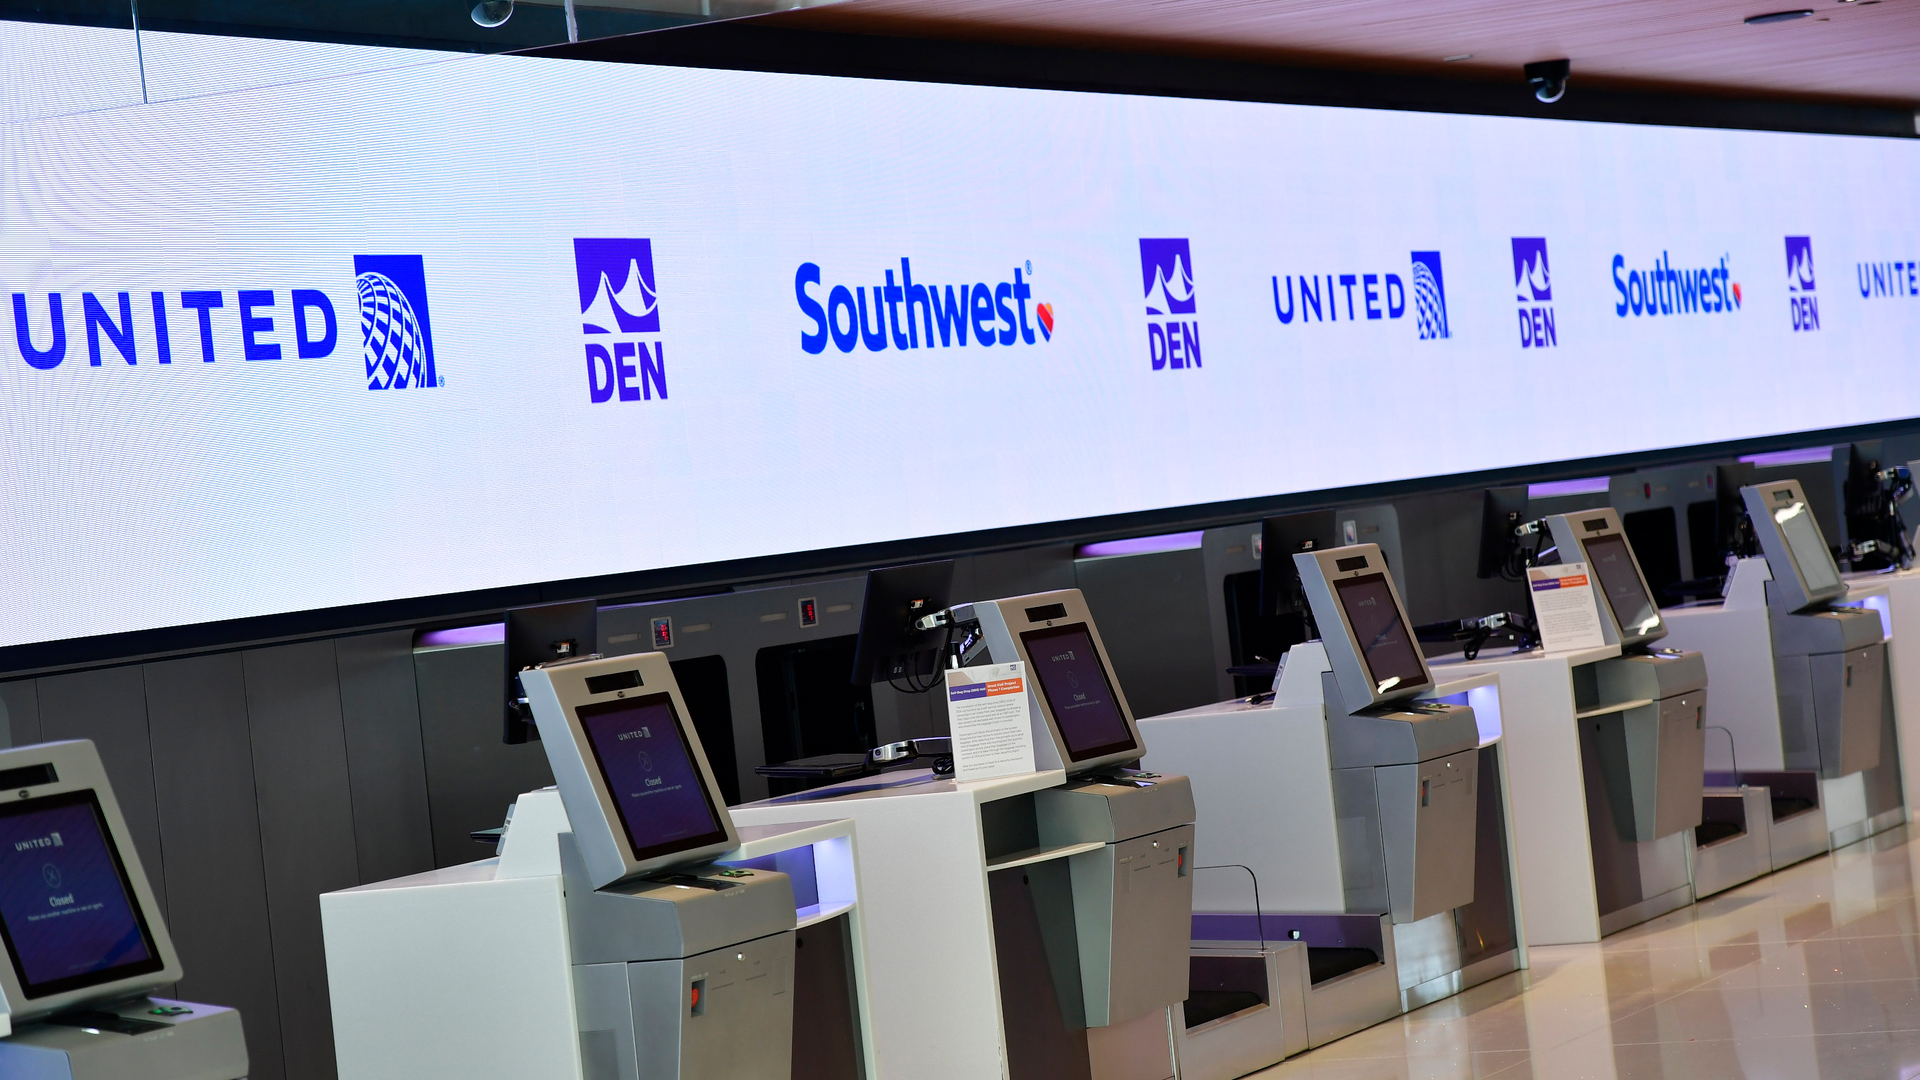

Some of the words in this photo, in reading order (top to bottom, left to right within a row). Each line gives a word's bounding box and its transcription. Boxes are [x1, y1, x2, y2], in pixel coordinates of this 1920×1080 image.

[1272, 274, 1406, 324] UNITED
[1613, 250, 1733, 317] Southwest
[1857, 261, 1920, 299] UNITE
[795, 257, 1035, 354] Southwest
[1791, 297, 1820, 332] DEN
[12, 289, 338, 371] UNITED
[1148, 321, 1202, 371] DEN
[1519, 307, 1557, 348] DEN
[585, 341, 668, 403] DEN
[618, 730, 643, 740] UNITED
[645, 776, 662, 786] Closed
[15, 838, 51, 851] UNITED
[49, 893, 74, 907] Closed
